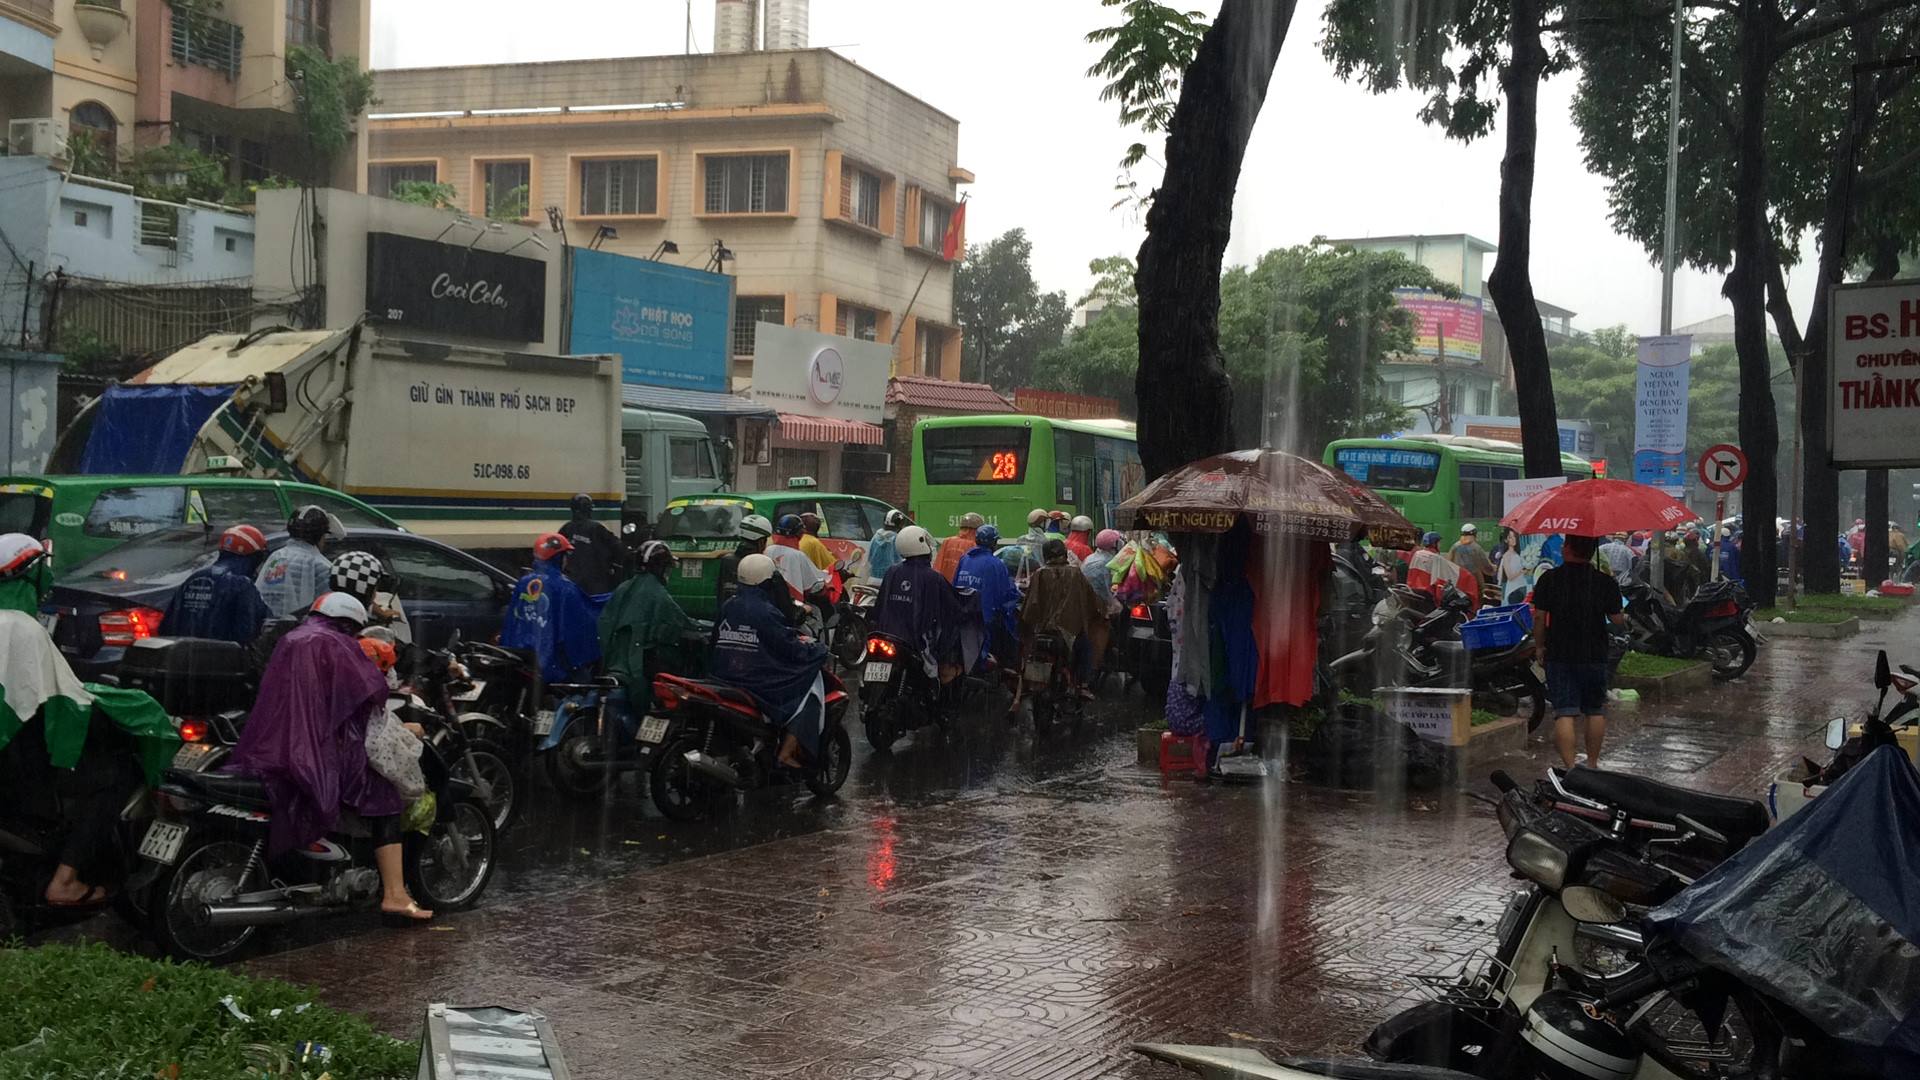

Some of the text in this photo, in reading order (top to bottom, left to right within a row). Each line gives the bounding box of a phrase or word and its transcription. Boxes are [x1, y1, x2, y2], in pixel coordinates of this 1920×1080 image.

[431, 273, 468, 299] Ceci
[387, 308, 403, 320] 207
[671, 312, 694, 328] HỌC
[1856, 349, 1920, 368] CHUYÊN
[460, 386, 495, 408] THÀNH
[525, 395, 551, 415] SẠCH
[556, 398, 575, 417] ĐẸP
[473, 463, 530, 479] 51C-098.68
[992, 452, 1015, 479] 28
[1660, 506, 1684, 522] AVIS
[1538, 517, 1580, 530] AVIS
